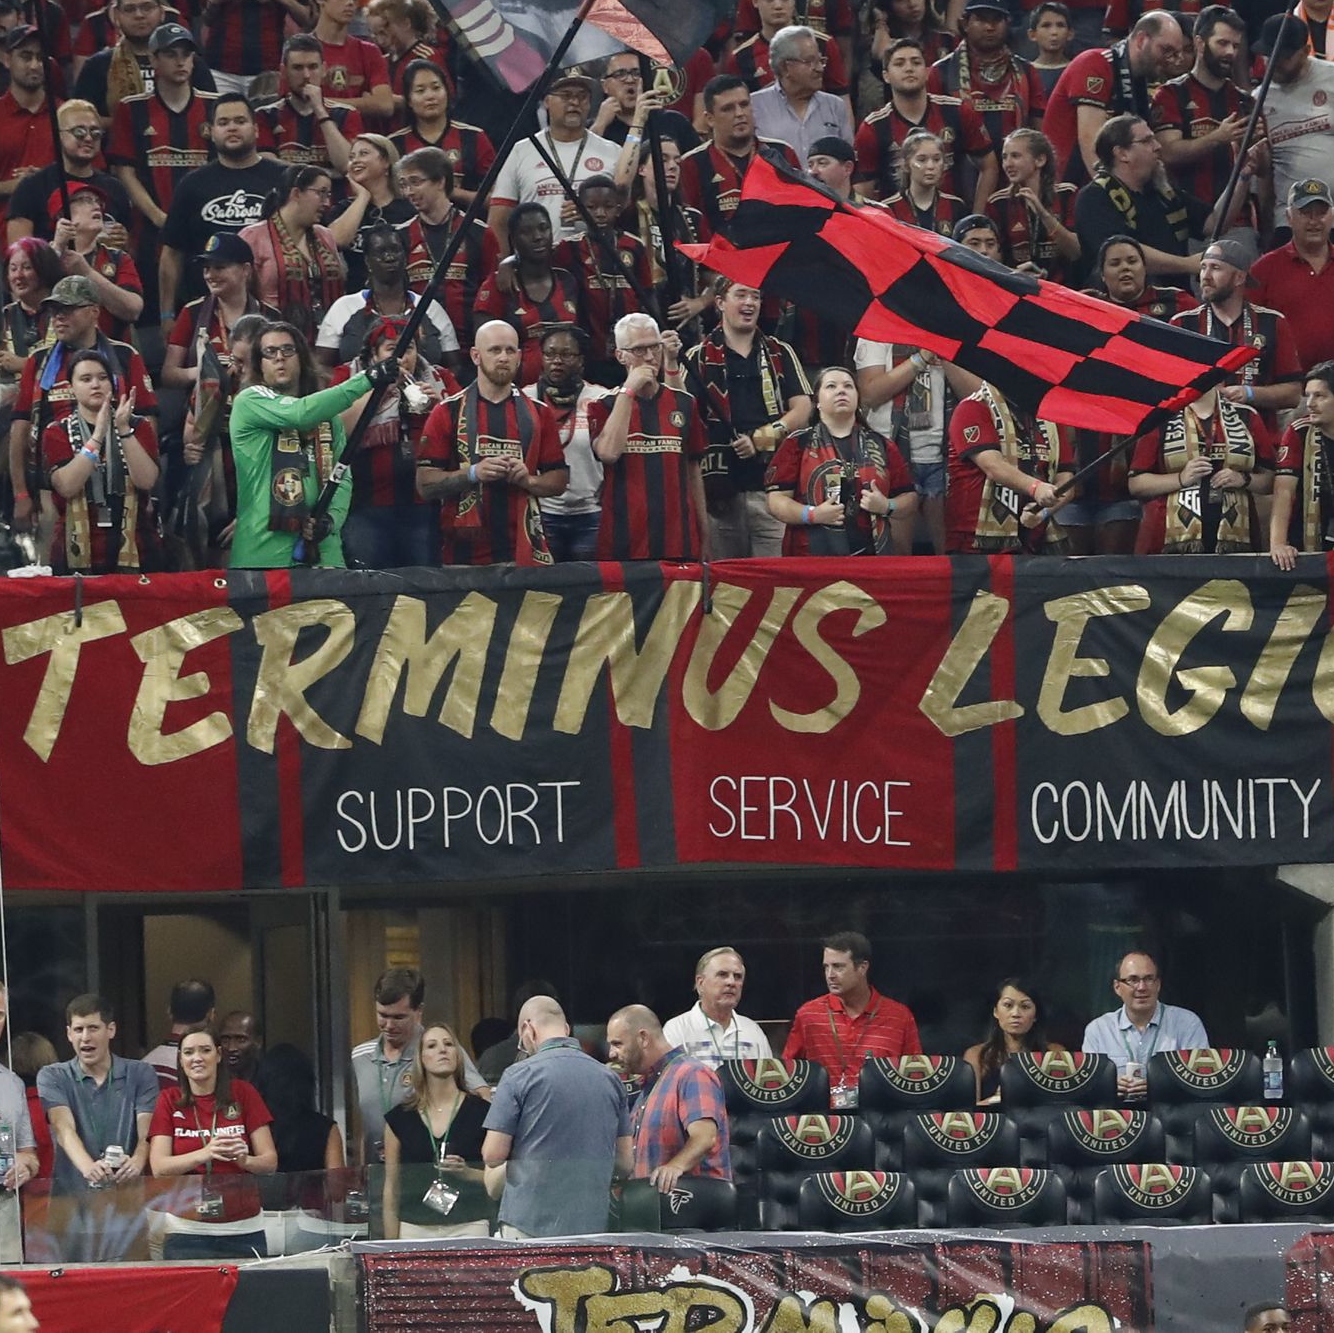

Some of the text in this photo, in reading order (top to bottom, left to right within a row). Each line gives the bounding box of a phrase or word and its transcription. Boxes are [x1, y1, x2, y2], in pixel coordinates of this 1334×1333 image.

[627, 439, 656, 447] MERICAN
[2, 578, 886, 766] TERMINUS
[336, 781, 581, 853] SUPPORT
[708, 774, 913, 846] SERVICE
[1030, 777, 1323, 845] COMMUNITY
[743, 1075, 805, 1101] UNITED FC
[887, 1068, 948, 1092] UNITED FC
[1027, 1067, 1091, 1090] UNITED FC
[1176, 1065, 1238, 1087] UNITED FC
[783, 1132, 845, 1156] UNITED FC
[926, 1128, 990, 1151] UNITED FC
[1082, 1122, 1143, 1151] UNITED FC
[1224, 1121, 1285, 1146] UNITED FC
[833, 1183, 896, 1213] UNITED FC
[974, 1185, 1036, 1207] UNITED FC
[1127, 1179, 1190, 1206] UNITED FC
[1269, 1178, 1331, 1204] UNITED FC
